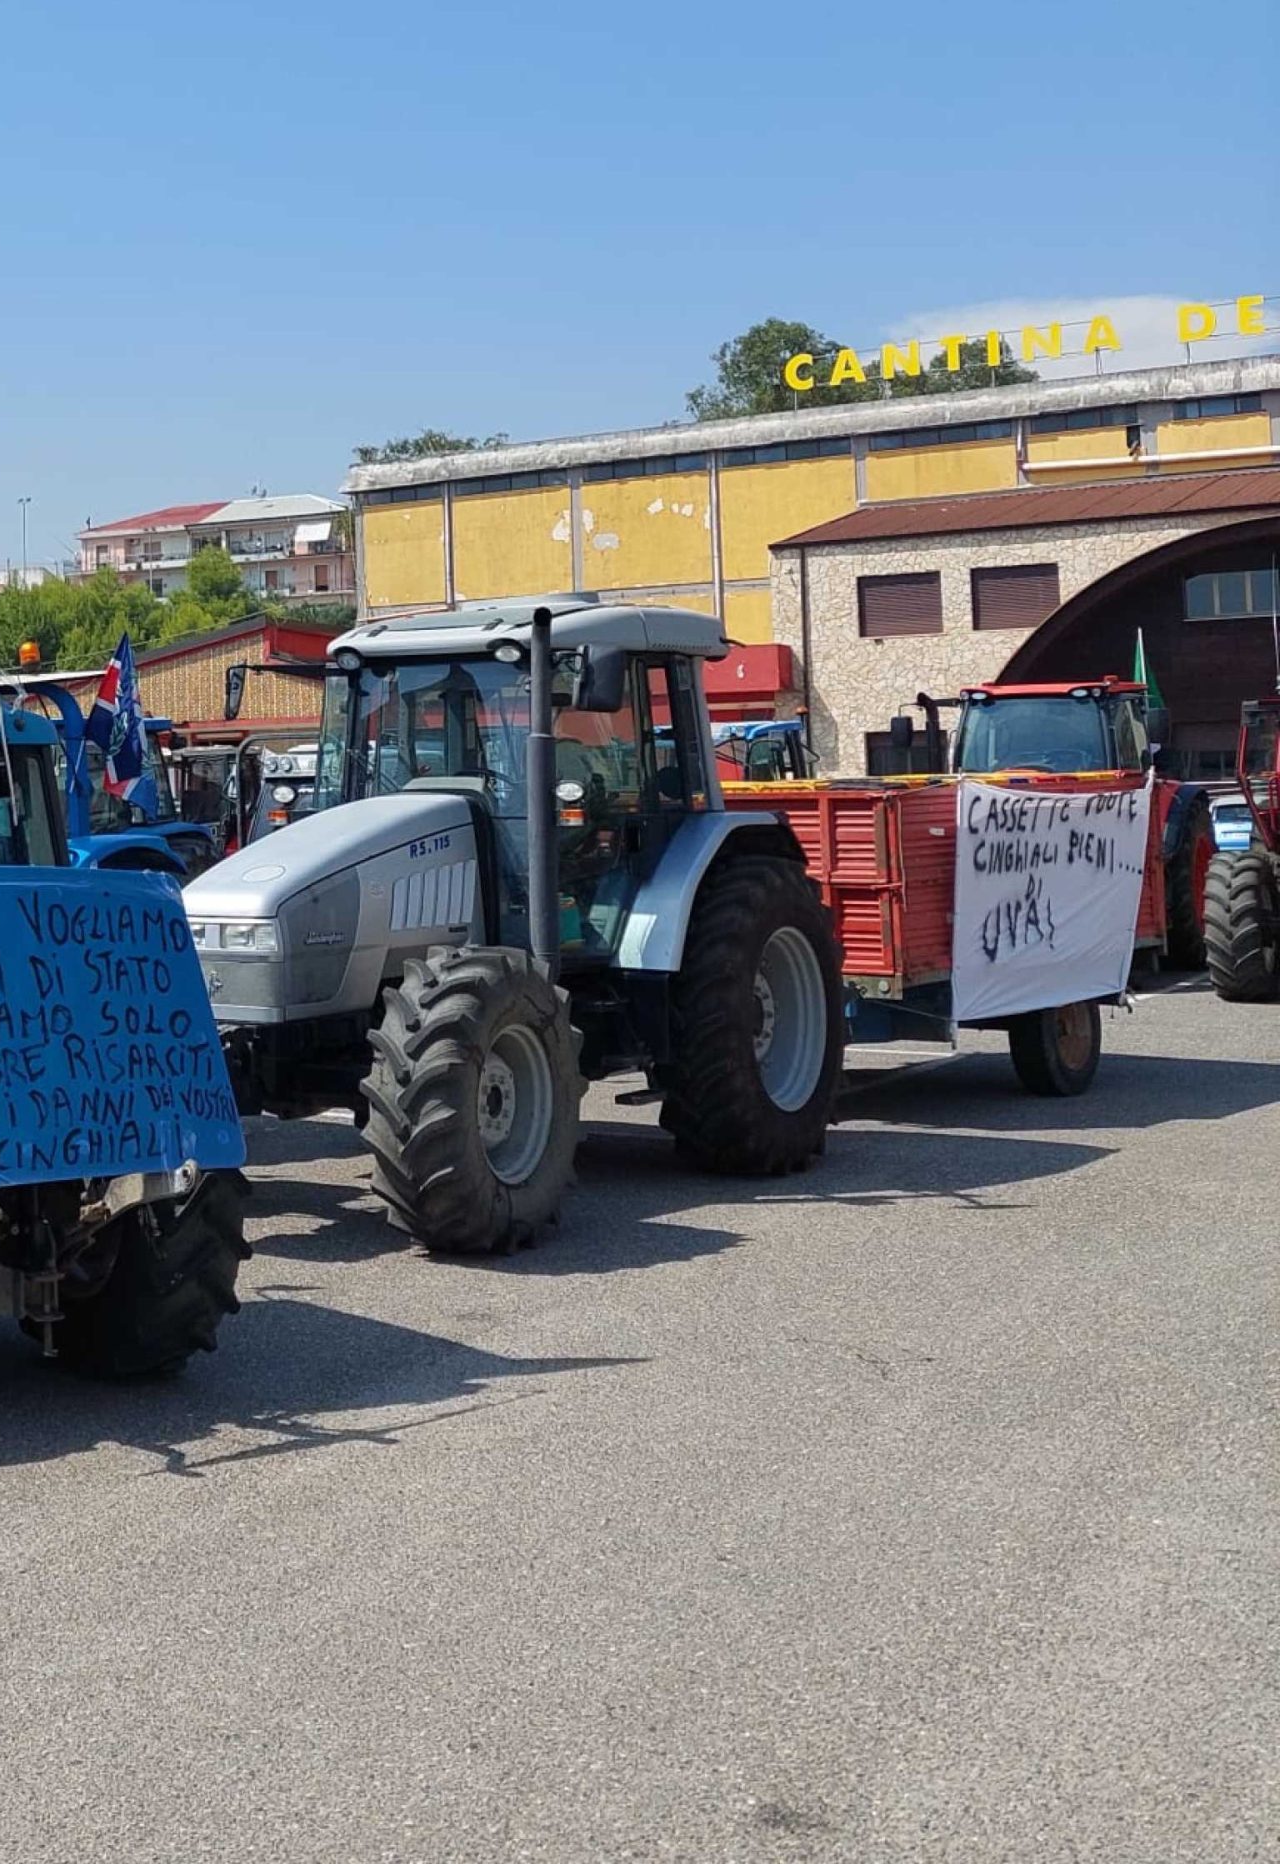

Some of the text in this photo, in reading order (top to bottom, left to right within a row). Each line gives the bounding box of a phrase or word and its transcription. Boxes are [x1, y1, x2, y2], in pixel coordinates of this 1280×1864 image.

[784, 295, 1266, 391] CANTINA DE
[1024, 873, 1042, 900] DI
[17, 890, 191, 954] VOGLIAMO
[83, 948, 172, 997] STATO
[99, 1000, 192, 1039] SOLO
